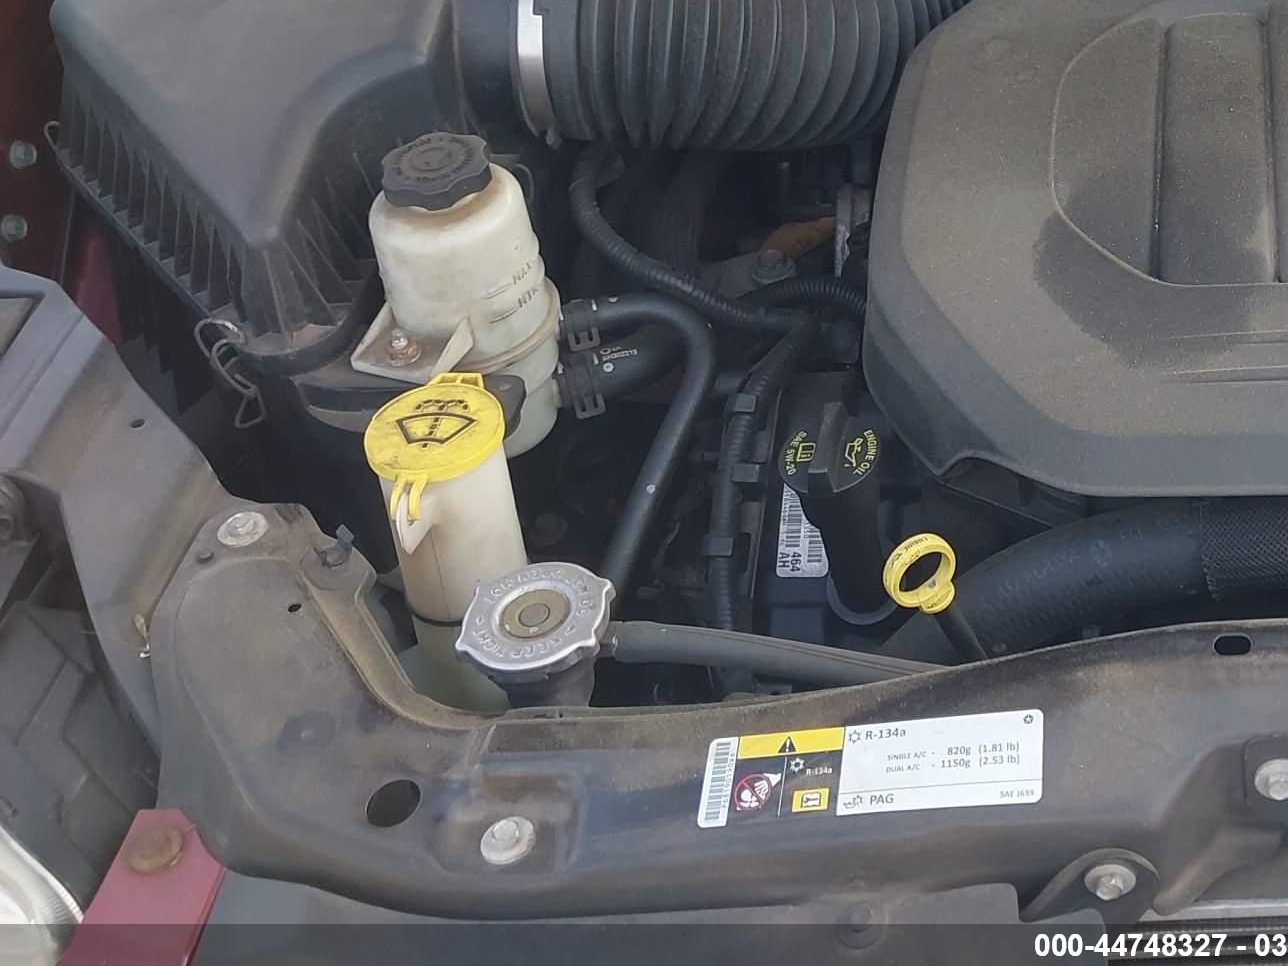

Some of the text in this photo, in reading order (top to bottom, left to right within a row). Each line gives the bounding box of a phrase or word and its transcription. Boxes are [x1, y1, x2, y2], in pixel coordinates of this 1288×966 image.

[512, 263, 533, 285] MAX
[790, 431, 807, 447] SAE
[852, 429, 879, 475] ENGINE OIL
[784, 449, 798, 476] 5W-20
[778, 552, 790, 568] AH
[790, 551, 802, 572] 464
[864, 727, 907, 740] R-134a
[887, 752, 911, 761] SINGLE
[913, 750, 927, 759] A/C
[947, 746, 972, 757] 820g
[978, 743, 1003, 756] (1.81
[1005, 741, 1020, 754] lb)
[806, 766, 833, 777] R-134a
[886, 764, 904, 773] DUAL
[905, 763, 920, 772] A/C
[940, 757, 971, 770] 1150g
[979, 755, 1003, 767] (2.53
[1005, 753, 1020, 766] lb)
[869, 787, 1035, 806] PAG SAE J639
